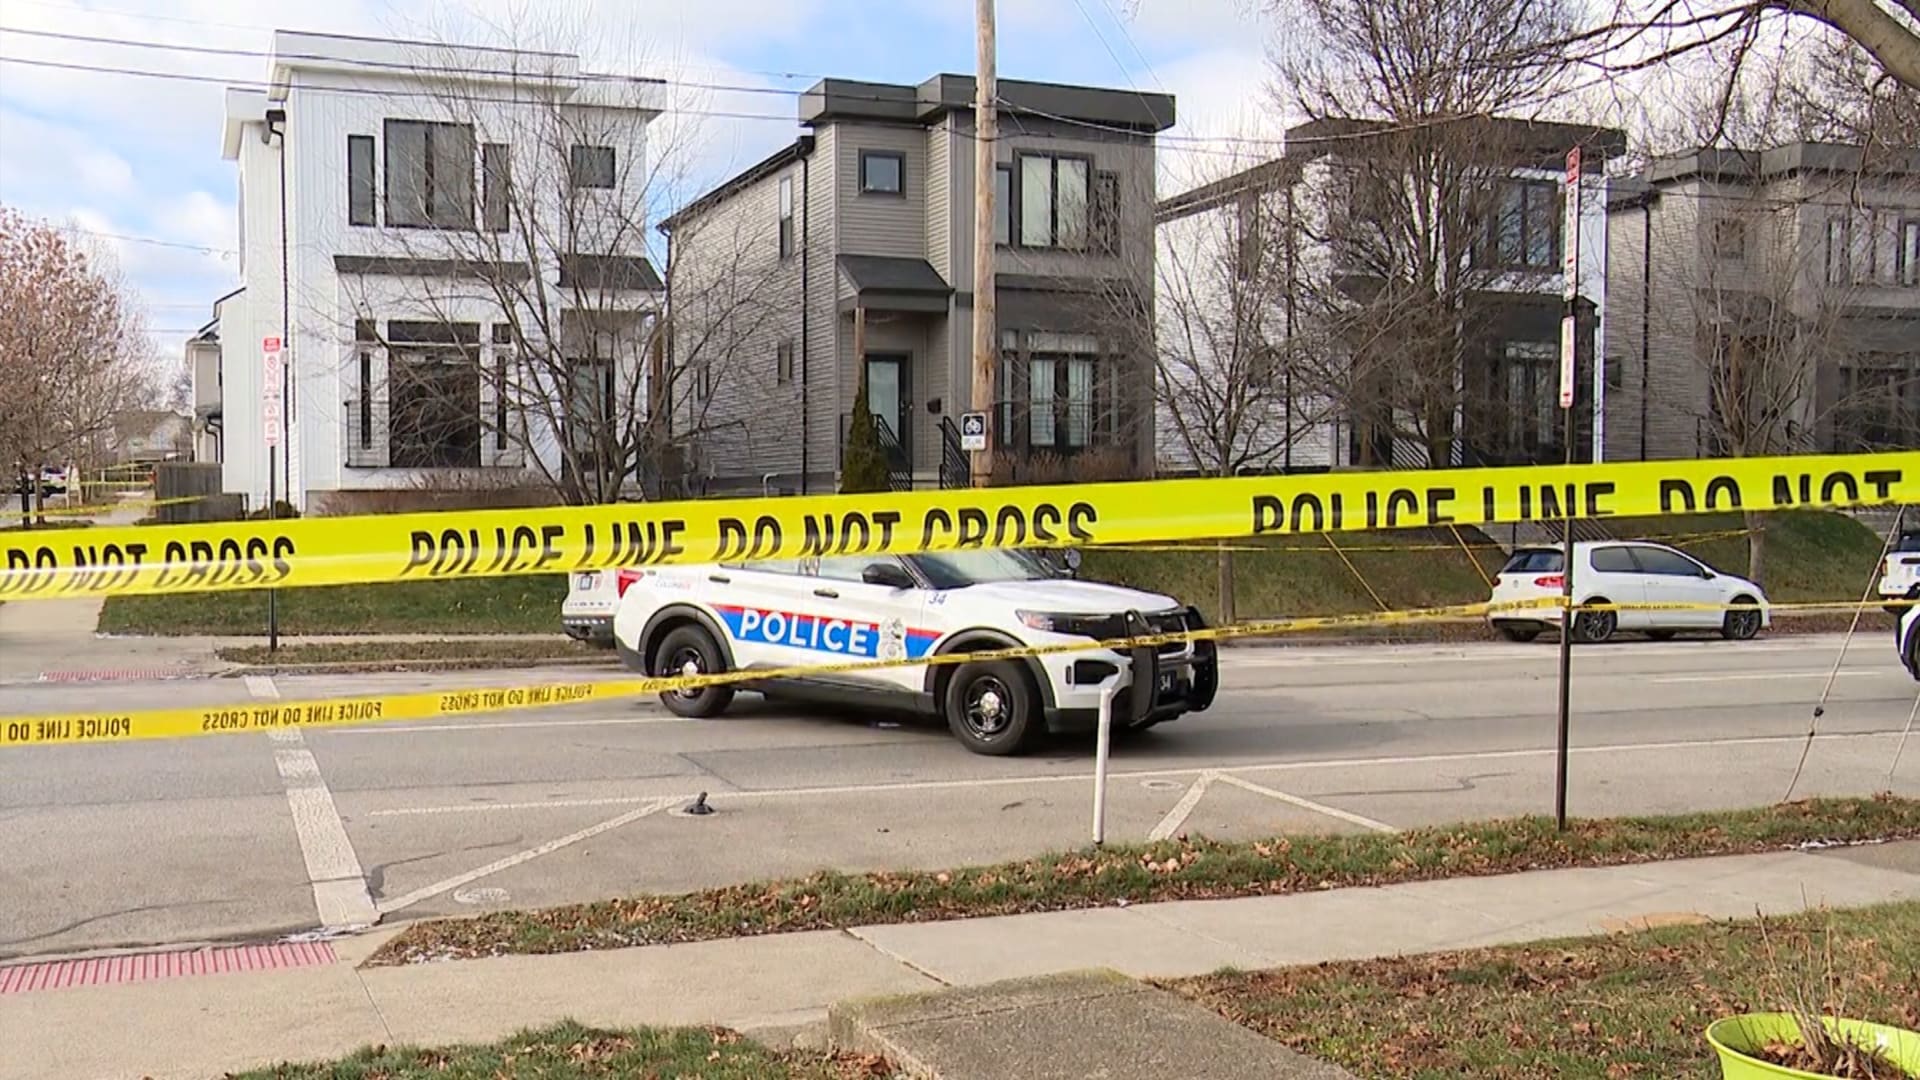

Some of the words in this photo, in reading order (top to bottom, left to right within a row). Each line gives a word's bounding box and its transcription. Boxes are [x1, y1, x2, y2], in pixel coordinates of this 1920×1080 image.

[1253, 491, 1455, 533] POLICE
[1484, 482, 1615, 520] LINE
[1660, 479, 1742, 511] DO
[1773, 471, 1902, 505] NOT
[1, 547, 57, 593] DO
[59, 543, 148, 592] NOT
[154, 536, 295, 588] CROSS
[401, 525, 564, 576] POLICE
[576, 520, 686, 568] LINE
[711, 516, 782, 560] DO
[800, 511, 900, 559] NOT
[921, 503, 1097, 551] CROSS
[928, 593, 948, 605] 34
[738, 608, 869, 655] POLICE
